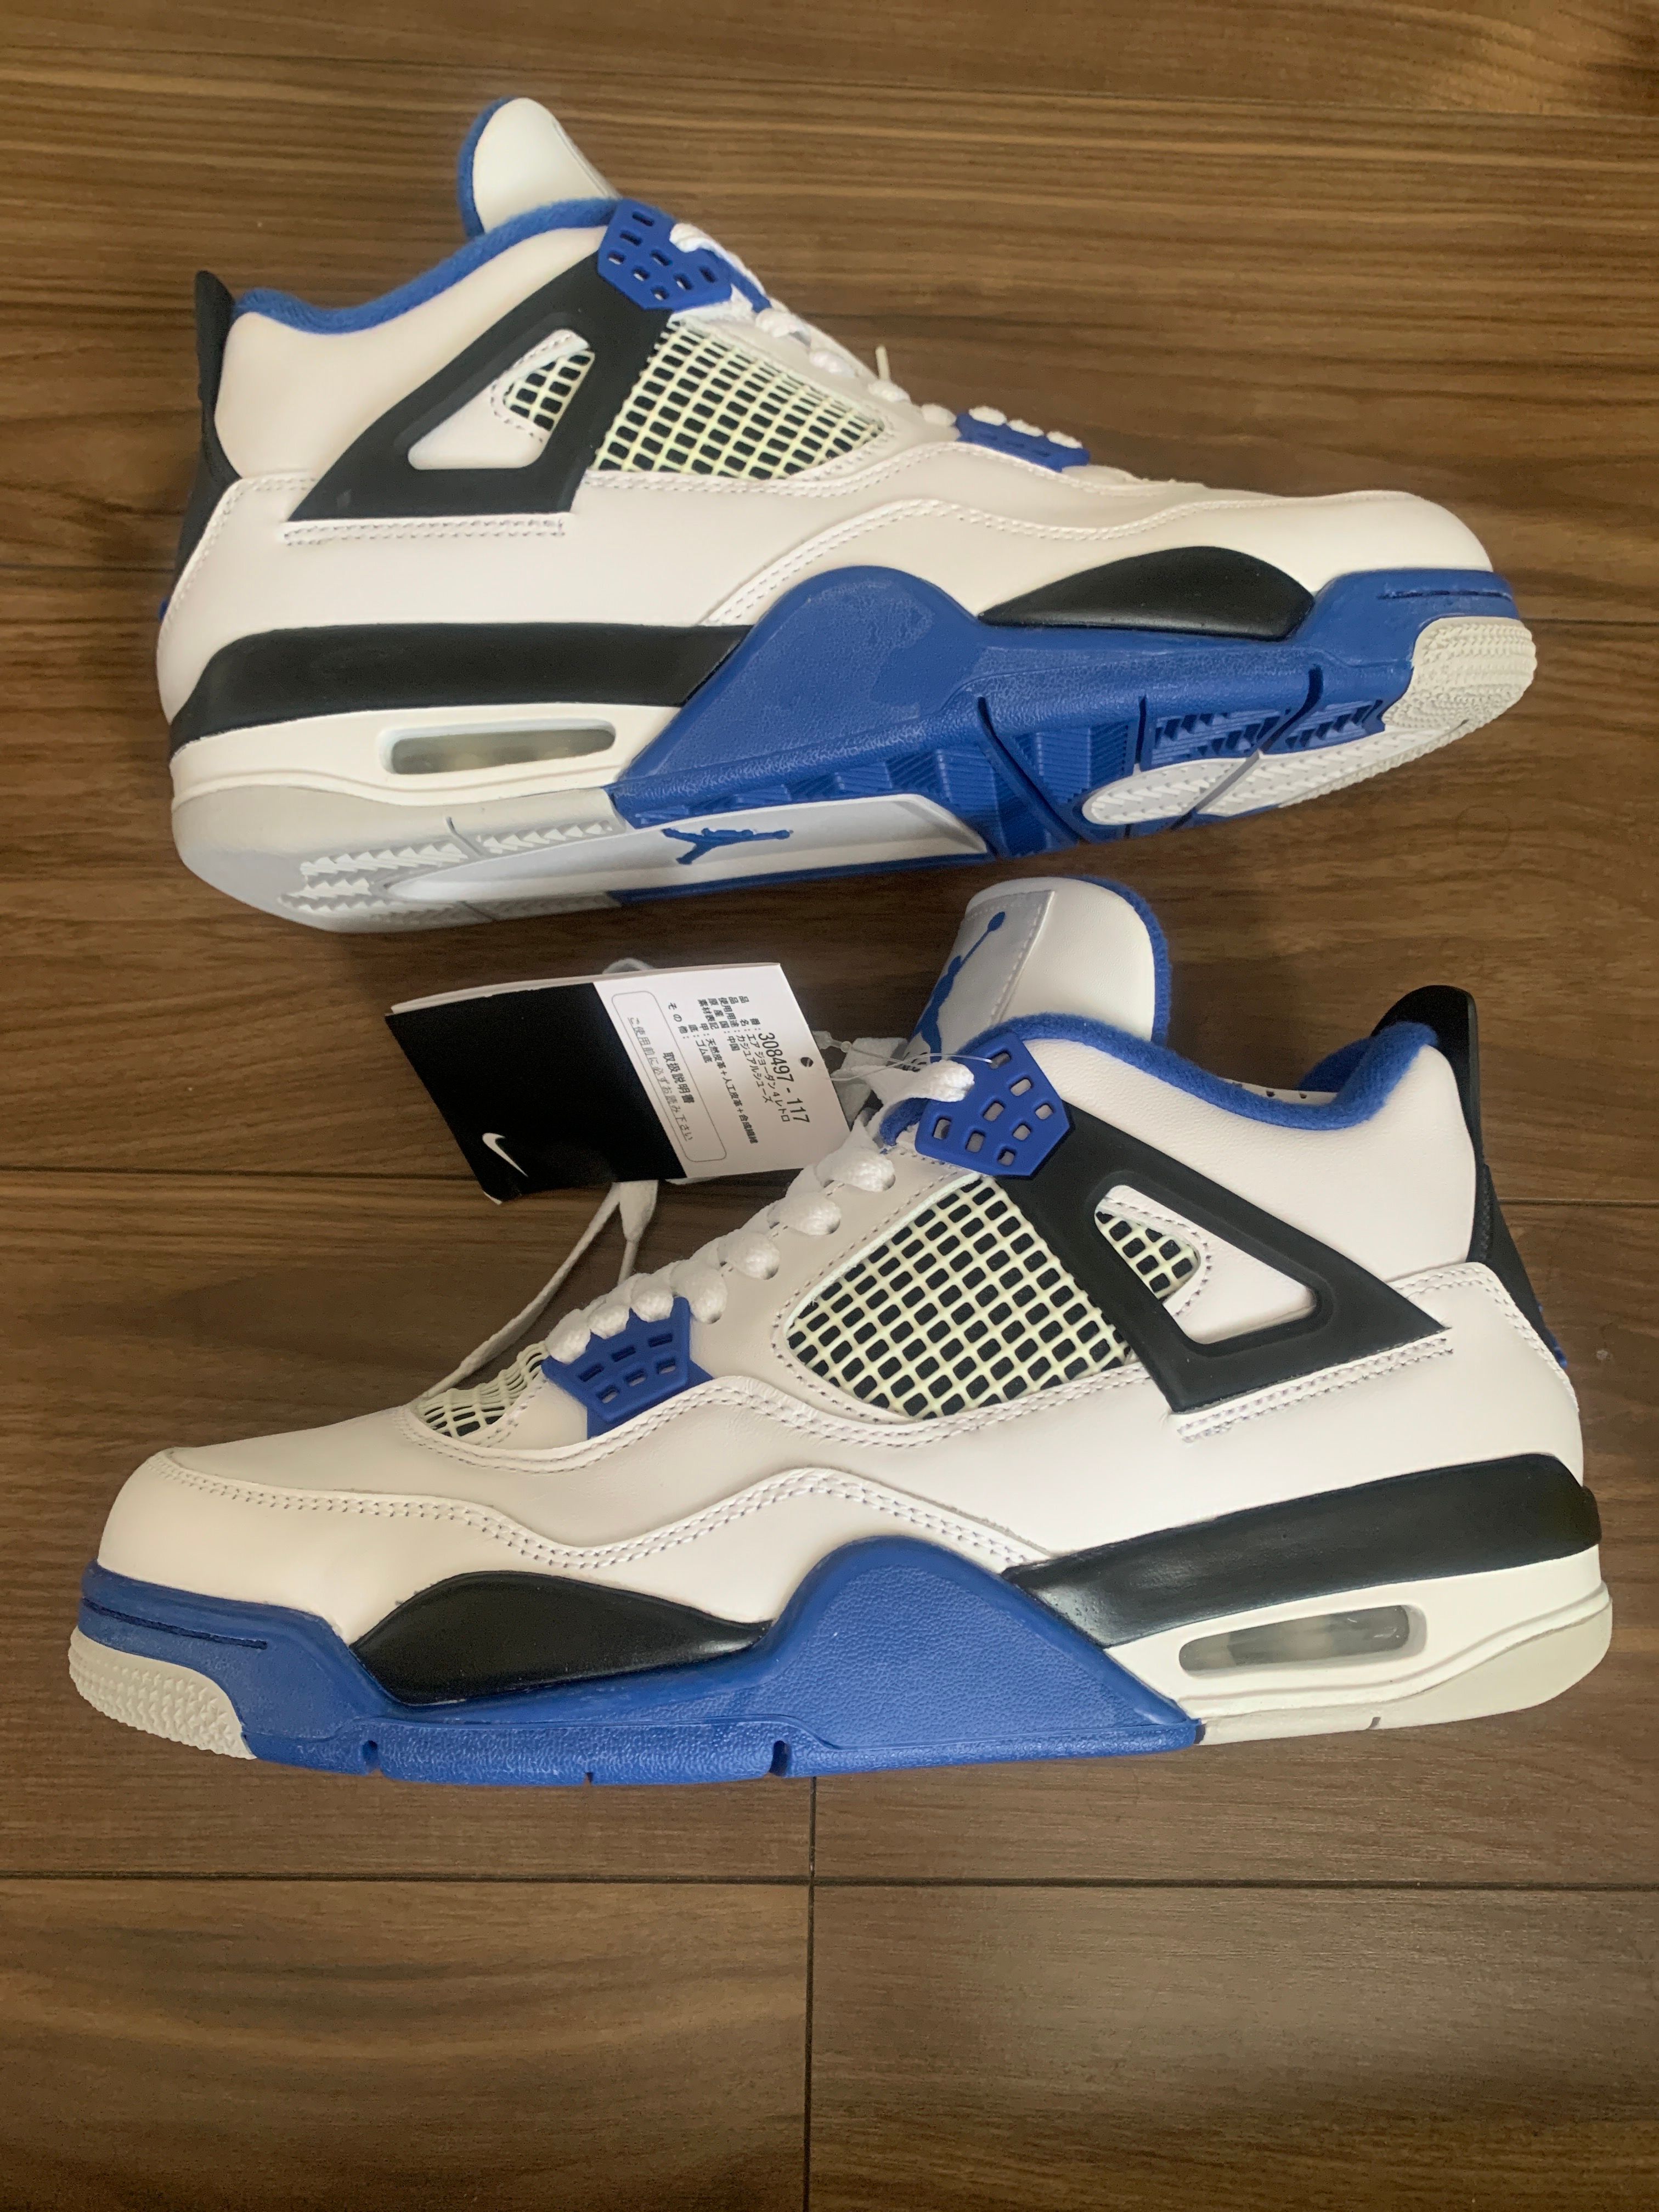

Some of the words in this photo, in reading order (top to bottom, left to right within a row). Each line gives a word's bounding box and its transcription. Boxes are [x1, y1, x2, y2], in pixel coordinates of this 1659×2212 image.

[630, 1018, 693, 1141] ご使用前に必ずお読み下さい
[663, 1052, 695, 1104] 取扱説明書
[758, 1032, 794, 1082] 308497
[787, 1098, 810, 1123] 117
